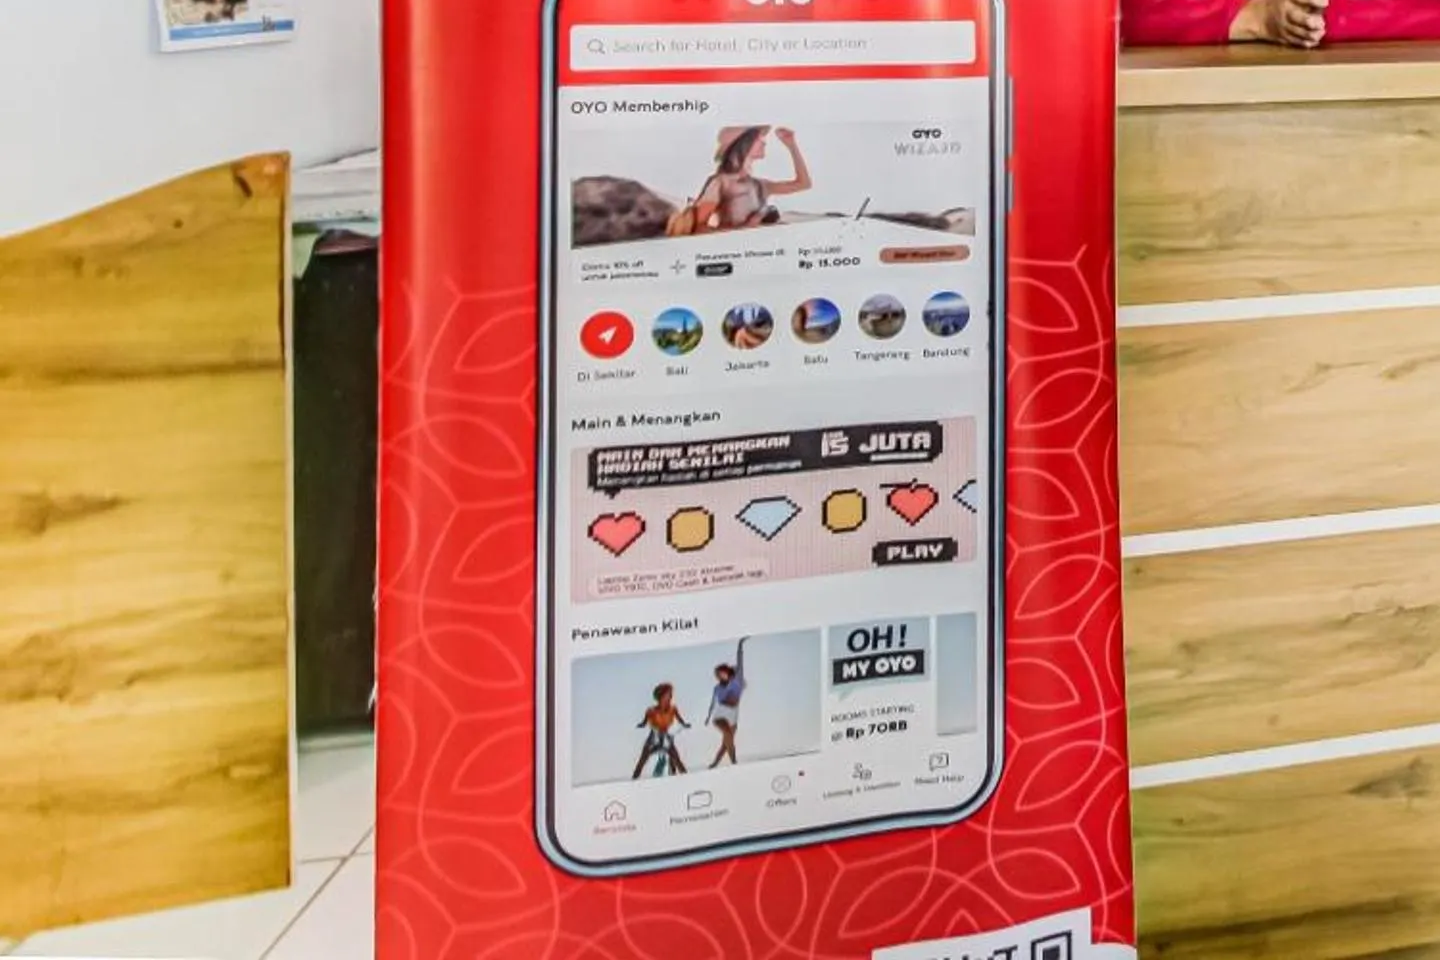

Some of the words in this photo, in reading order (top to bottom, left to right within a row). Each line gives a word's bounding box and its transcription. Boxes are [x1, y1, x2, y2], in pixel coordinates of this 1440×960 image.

[613, 37, 665, 53] Search
[670, 37, 690, 52] for
[748, 36, 779, 54] City
[782, 39, 799, 50] or
[803, 35, 868, 51] Location
[571, 101, 608, 115] OYO
[613, 99, 710, 116] Membership
[571, 416, 611, 432] Main
[615, 415, 627, 428] &
[631, 409, 721, 427] Menangkan
[859, 431, 932, 454] JUTA
[887, 543, 944, 561] PLAY
[571, 623, 657, 641] Penawaran
[662, 617, 698, 632] Kilat
[842, 660, 871, 679] MY
[874, 655, 917, 674] OYO
[845, 726, 865, 741] Rp
